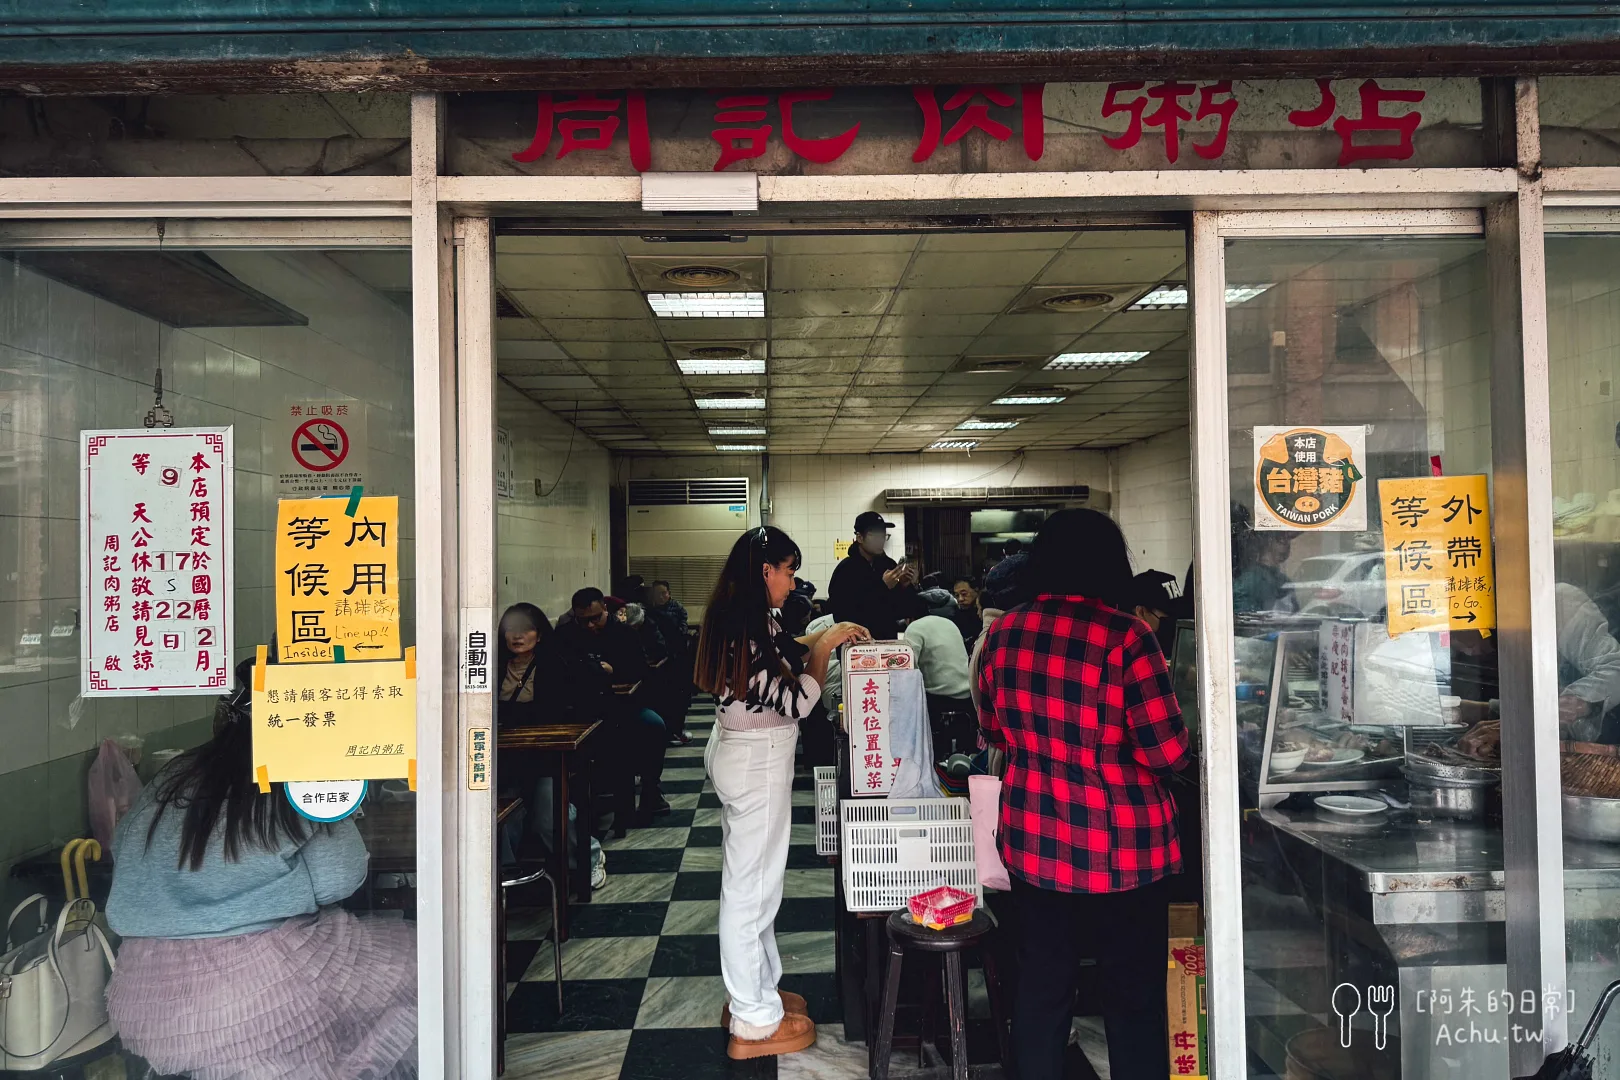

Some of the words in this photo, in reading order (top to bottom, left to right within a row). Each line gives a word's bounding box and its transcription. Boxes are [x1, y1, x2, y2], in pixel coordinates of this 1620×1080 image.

[291, 405, 348, 417] 禁止吸菸
[1294, 437, 1316, 449] 本店
[132, 453, 151, 476] 等
[1294, 451, 1316, 463] 使用
[162, 469, 179, 485] 9
[1266, 467, 1344, 494] 台灣豬
[1276, 503, 1311, 523] TAIWAN
[1313, 503, 1339, 522] PORK
[1441, 494, 1482, 569] 外帶
[155, 553, 191, 571] 17
[189, 451, 213, 672] 本店預定於國曆2月
[343, 515, 388, 596] 內用
[1391, 496, 1436, 616] 等候區
[103, 534, 121, 633] 周記肉粥店
[131, 502, 154, 671] 天公休敬請見諒
[284, 515, 331, 644] 等候區
[156, 601, 192, 619] 22
[1445, 596, 1460, 609] To
[164, 633, 179, 650] 日
[335, 625, 360, 640] Line
[284, 646, 332, 660] Inside!
[468, 630, 487, 684] 自動門
[103, 655, 122, 672] 啟
[267, 685, 404, 704] 懇請顧客記得索取
[267, 711, 337, 728] 統一發票
[862, 678, 883, 789] 去找位置點菜
[346, 743, 405, 757] 周記肉粥店
[302, 792, 350, 804] 合作店家
[1174, 1030, 1197, 1074] 味丹
